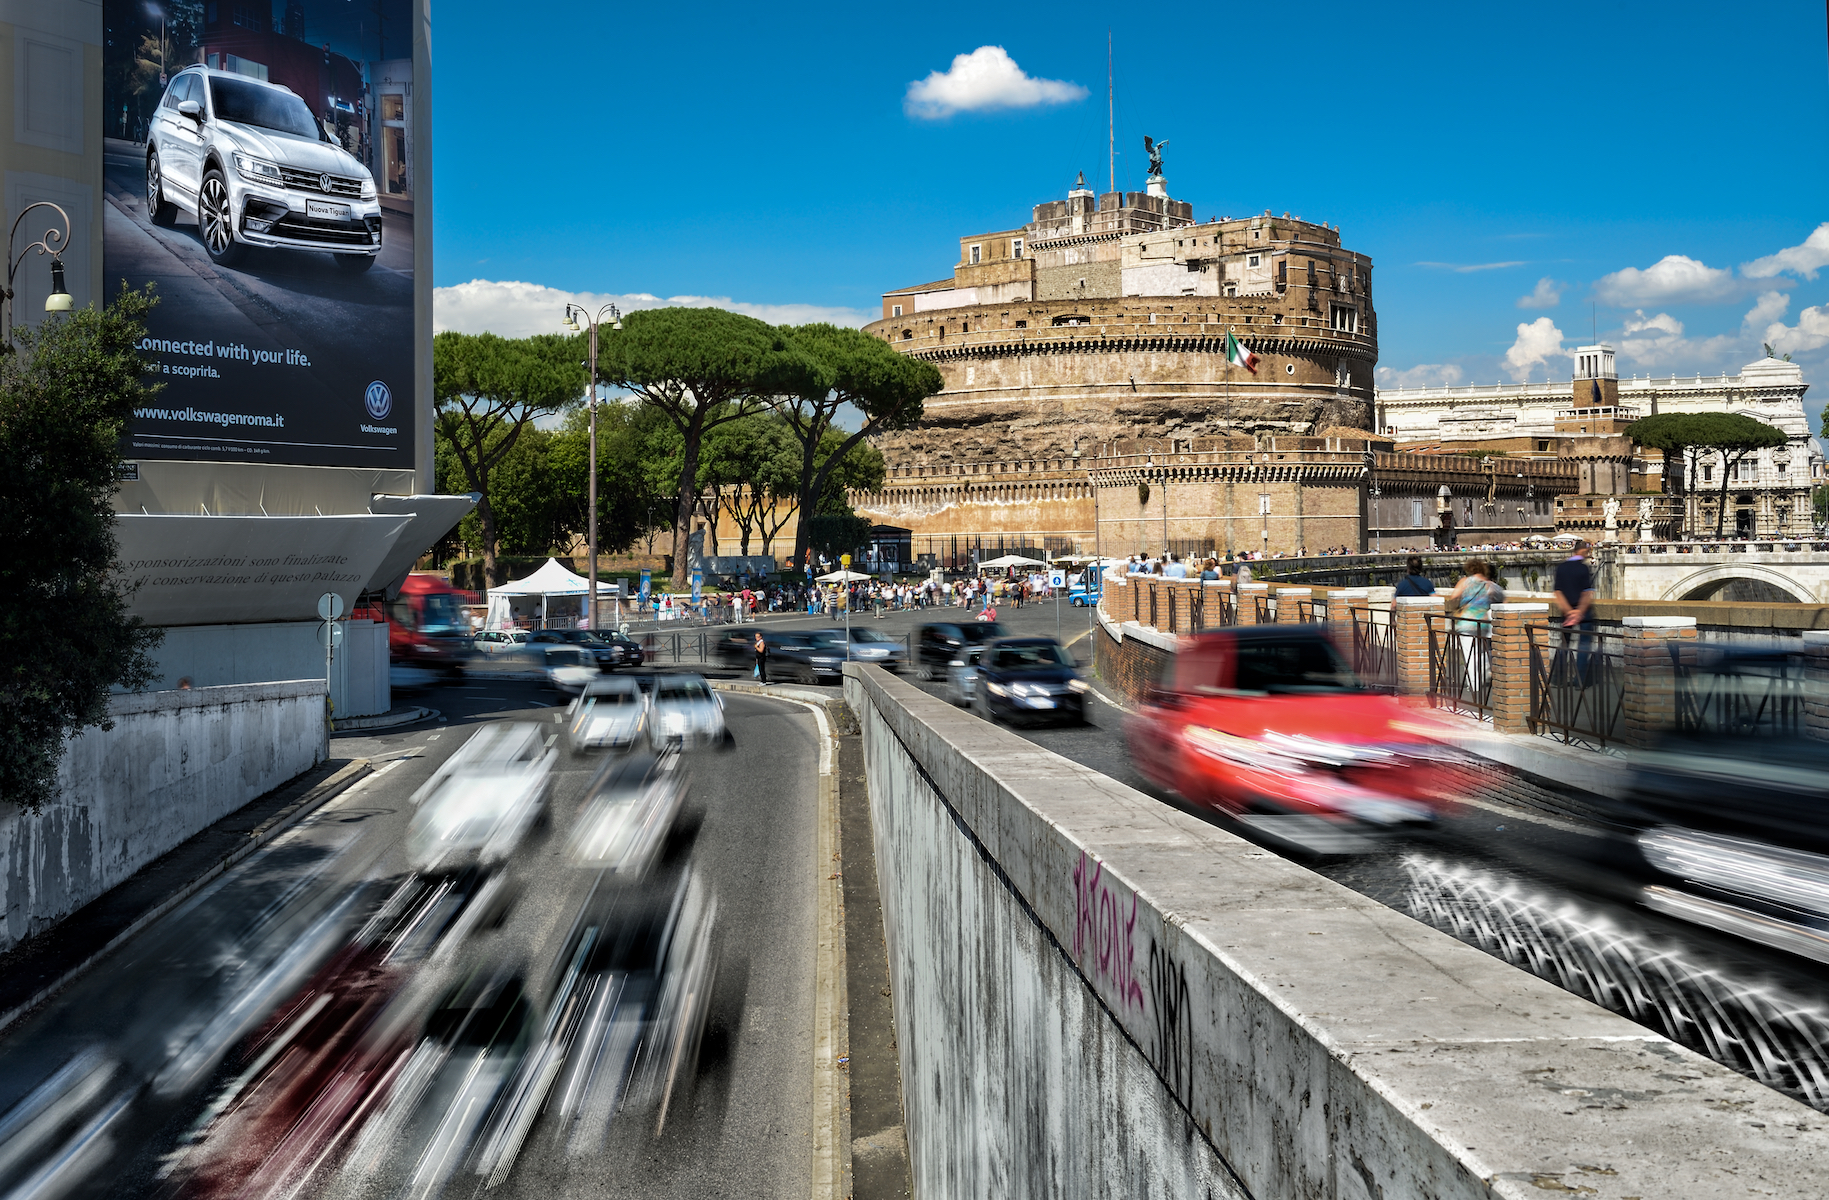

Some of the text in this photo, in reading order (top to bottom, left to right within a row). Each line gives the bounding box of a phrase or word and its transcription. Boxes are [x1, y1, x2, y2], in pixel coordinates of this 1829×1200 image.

[309, 205, 349, 216] Nuova Tiguan
[216, 343, 249, 360] with
[252, 350, 283, 365] your
[286, 348, 311, 367] life.
[163, 363, 170, 374] a
[172, 364, 221, 379] scoprirla.
[133, 406, 284, 427] www.volkswagenroma.it
[360, 424, 397, 435] Volkswagen
[127, 554, 247, 572] sponsorizzazioni
[249, 557, 279, 566] sono
[283, 554, 348, 565] finalizzate
[152, 572, 251, 586] conservazione
[254, 571, 269, 583] di
[270, 572, 311, 585] questo
[311, 570, 361, 582] palazzo
